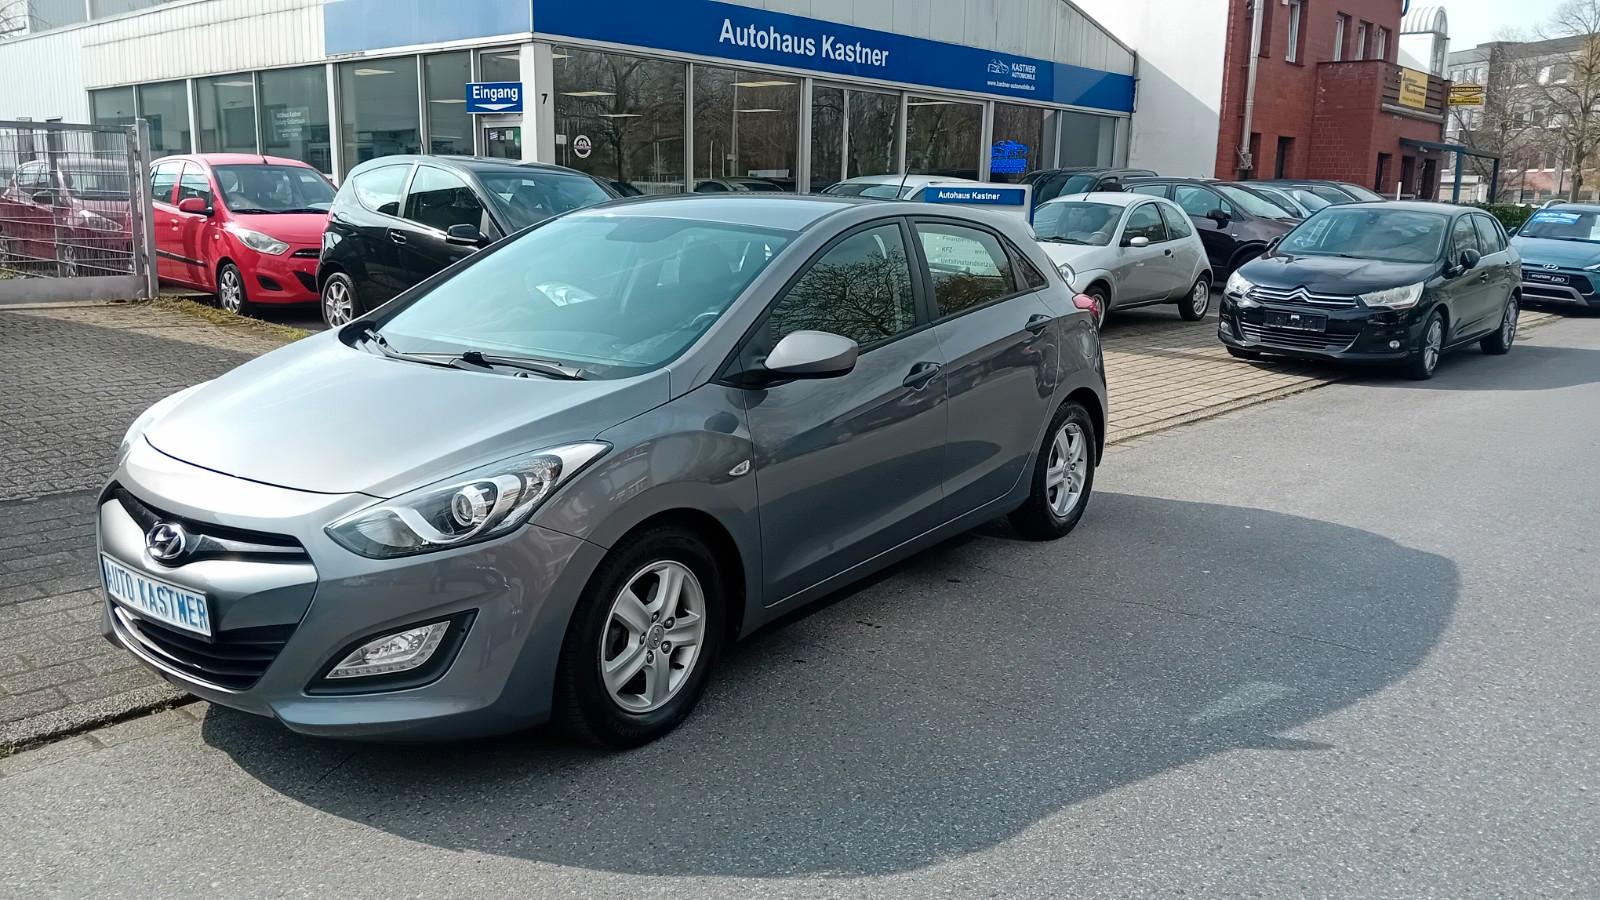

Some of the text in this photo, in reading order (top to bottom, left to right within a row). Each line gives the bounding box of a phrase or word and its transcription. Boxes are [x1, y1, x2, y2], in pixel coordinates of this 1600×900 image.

[719, 18, 889, 67] Autohaus Kastner
[1011, 62, 1036, 74] KASTNER
[472, 86, 518, 102] Eingang
[541, 93, 548, 105] 7
[938, 191, 1000, 200] Autohaus Kastner
[941, 246, 953, 254] KFZ
[105, 560, 209, 631] AUTO KASTNER
